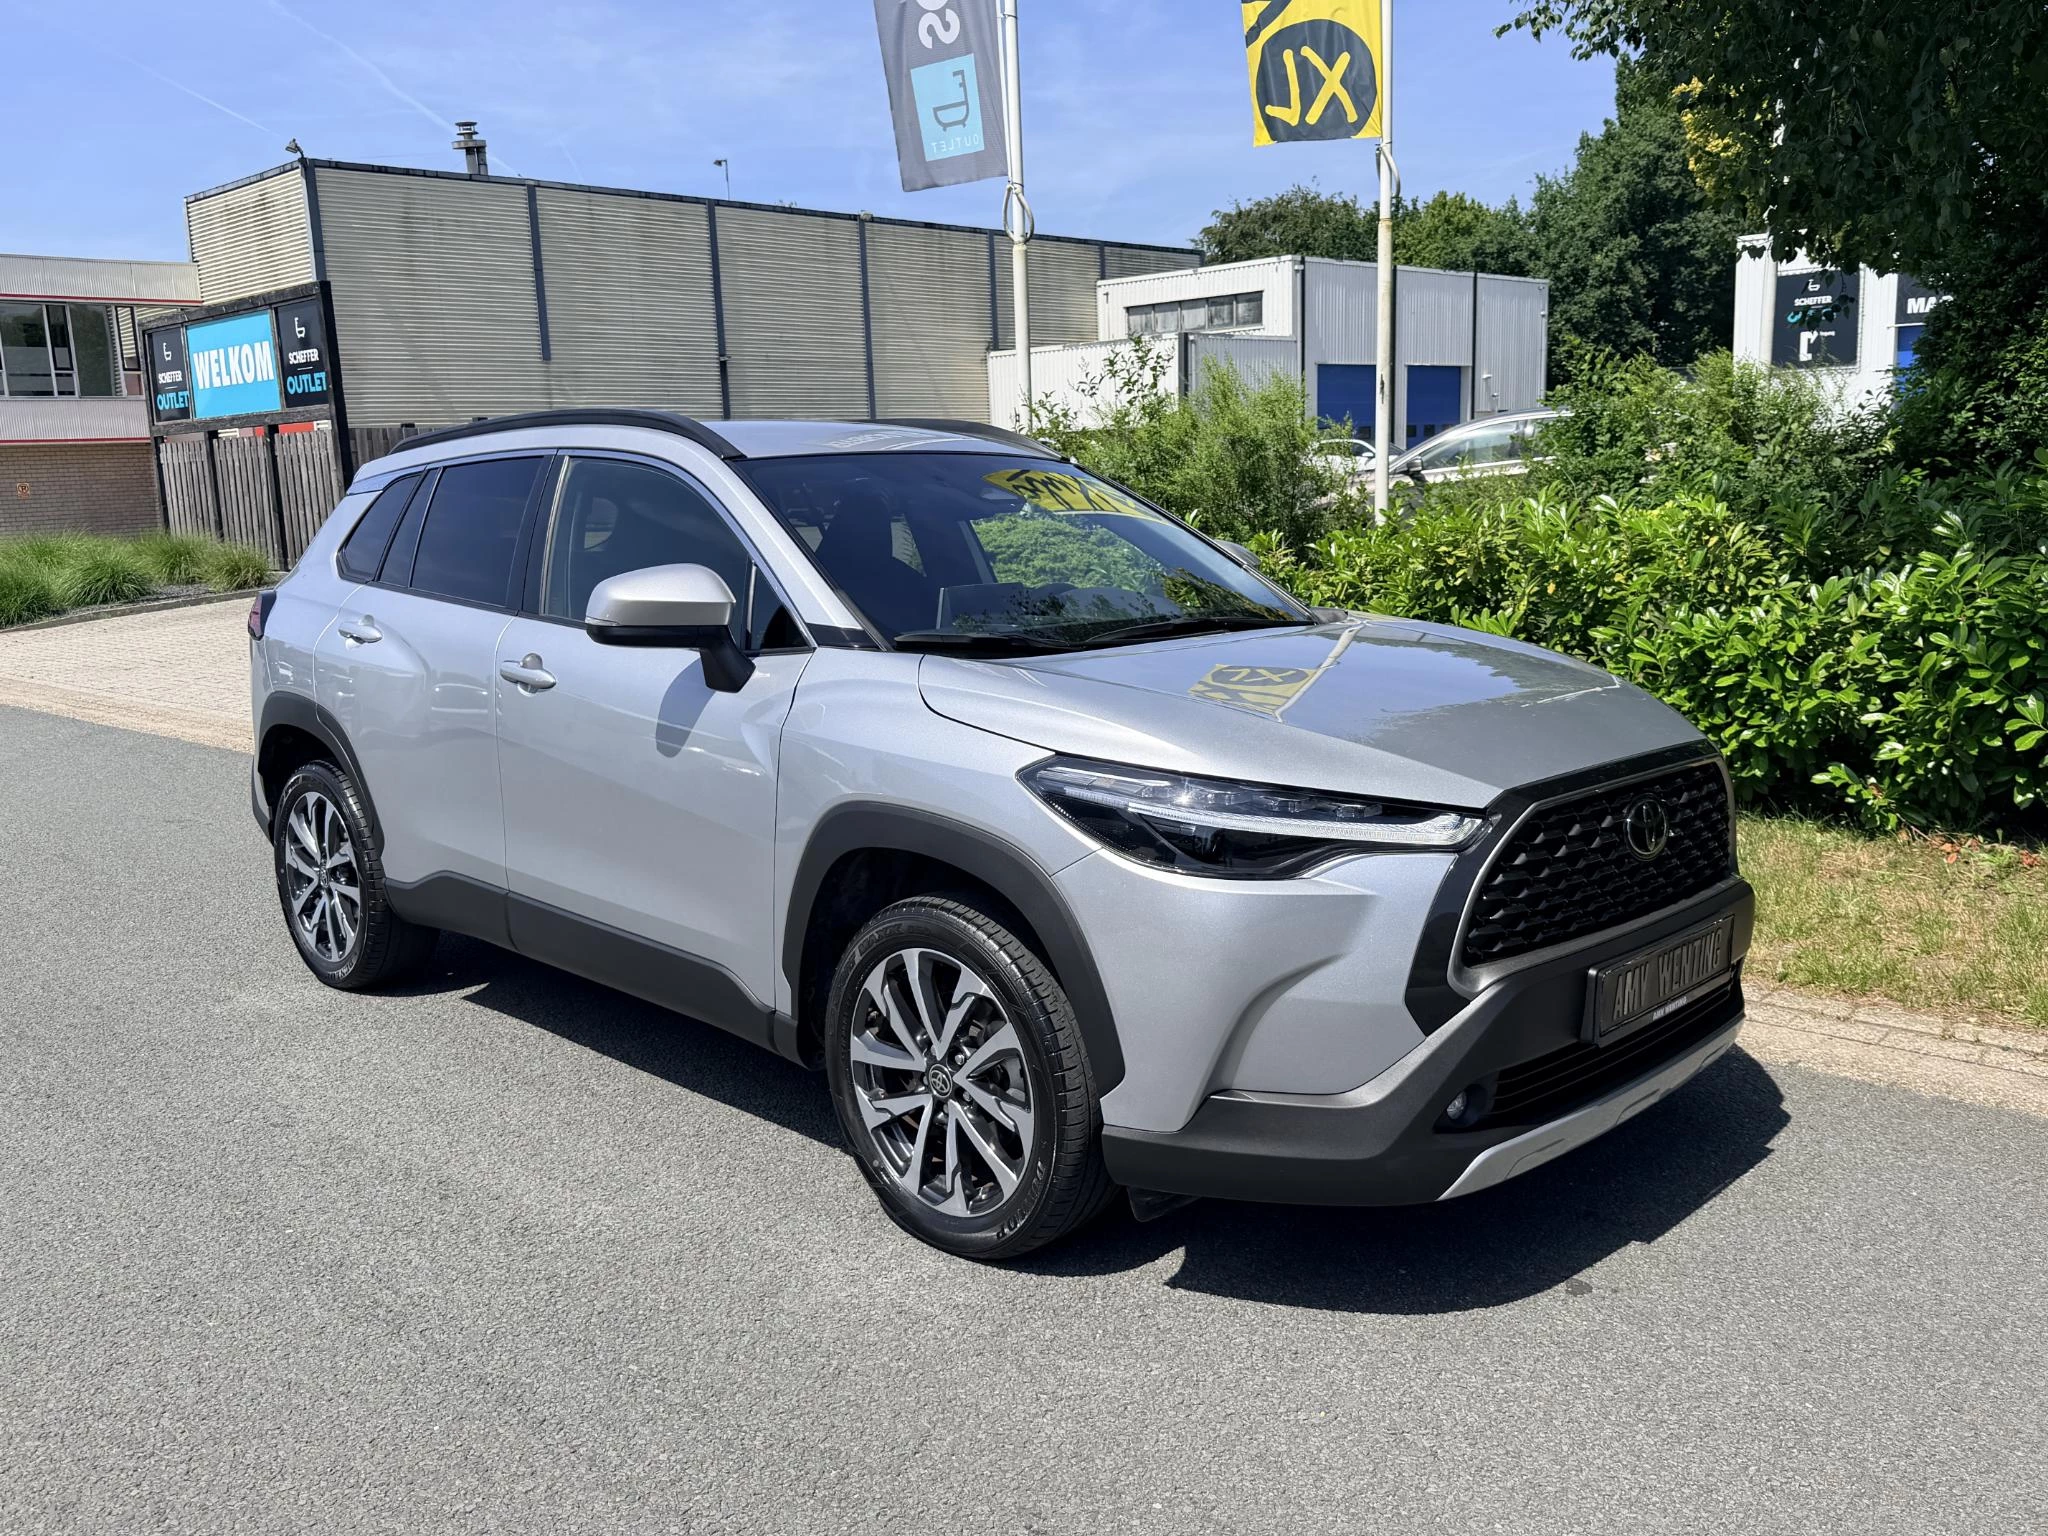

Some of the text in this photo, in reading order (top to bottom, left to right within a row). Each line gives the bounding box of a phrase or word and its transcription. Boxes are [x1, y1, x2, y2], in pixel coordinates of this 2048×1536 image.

[1794, 295, 1832, 306] SCHEFFER
[193, 341, 274, 389] WELKOM
[288, 349, 319, 365] SCHEFFER
[158, 370, 182, 384] SCHEFFER
[287, 372, 327, 395] OUTLET
[157, 390, 190, 411] OUTLET
[1613, 927, 1722, 1021] AMY WENTING
